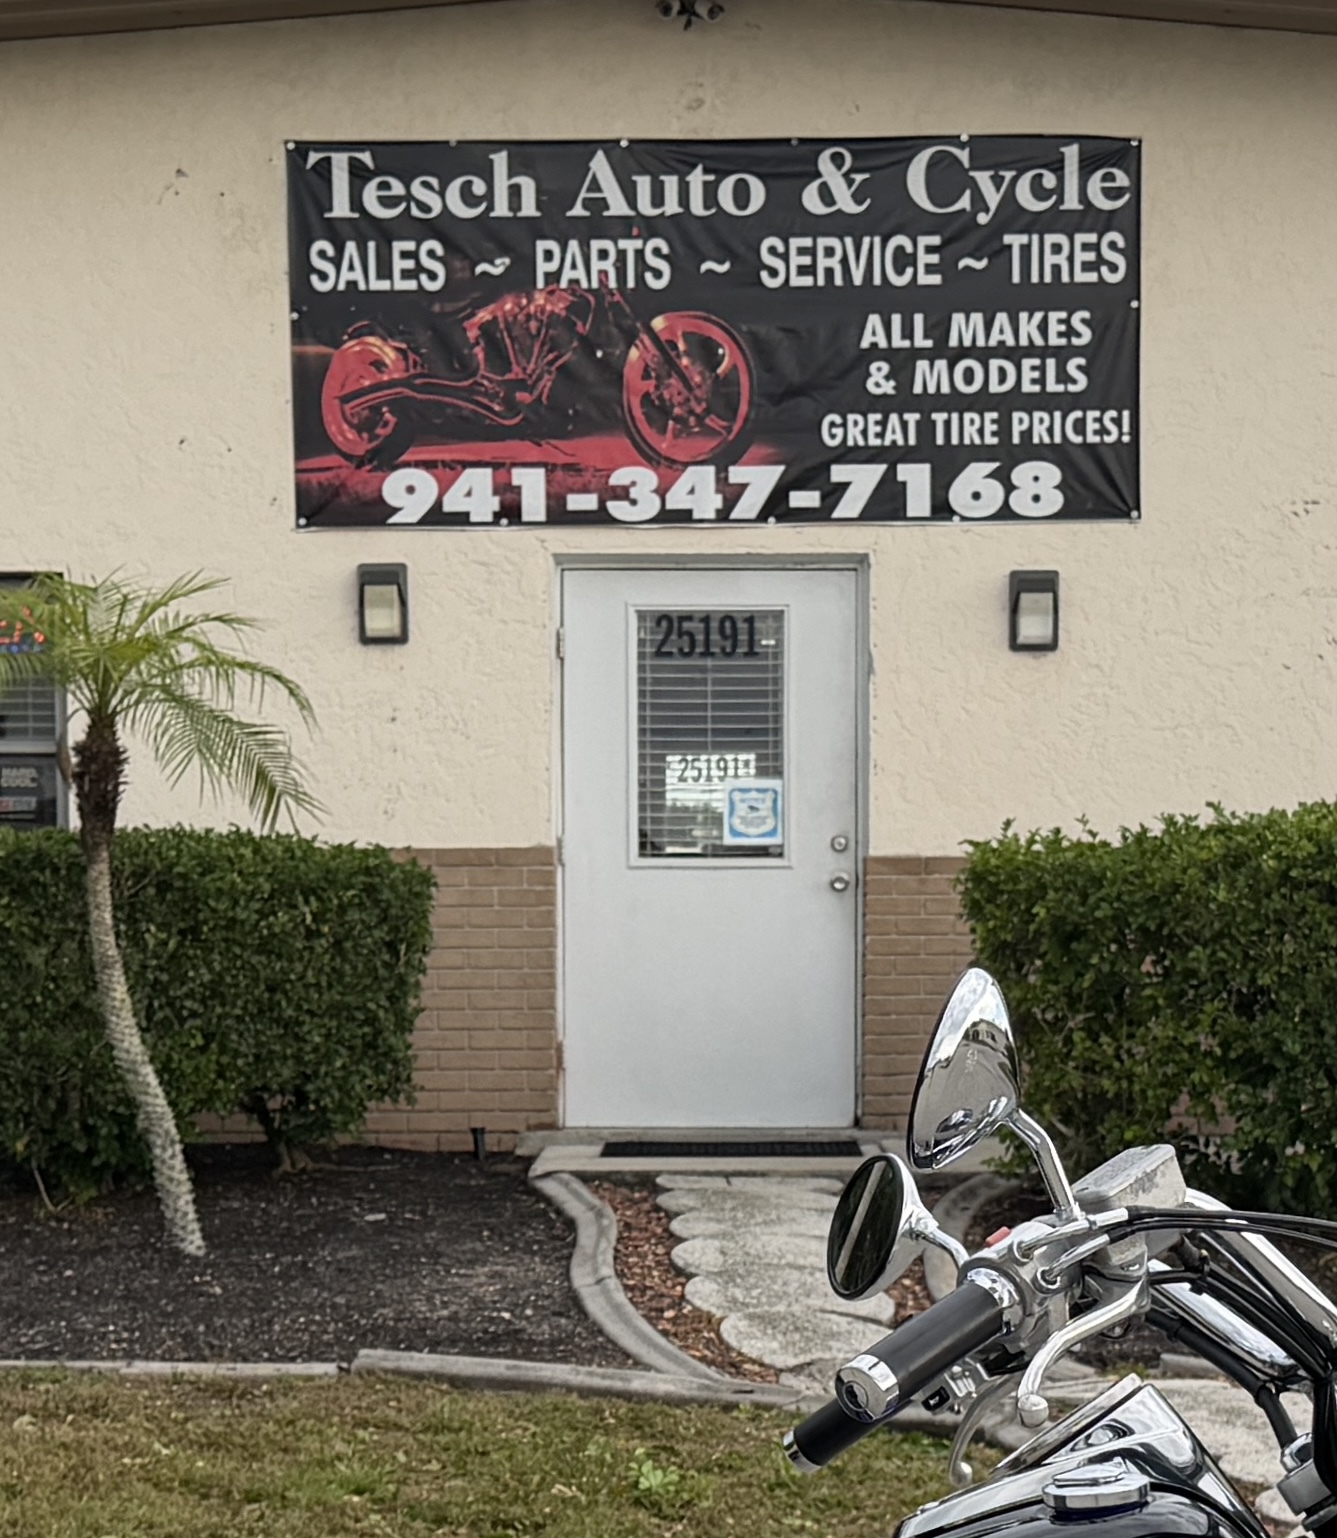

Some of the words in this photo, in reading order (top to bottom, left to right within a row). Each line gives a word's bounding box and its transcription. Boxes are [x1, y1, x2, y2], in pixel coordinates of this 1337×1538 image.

[305, 149, 542, 219] Tesch
[565, 148, 766, 217] Auto
[801, 146, 872, 216] &
[906, 143, 1131, 225] Cycle
[309, 239, 447, 292] SALES
[534, 237, 672, 290] PARTS
[759, 234, 942, 289] SERVICE
[1002, 231, 1127, 285] TIRES
[859, 312, 934, 349] ALL
[948, 310, 1093, 348] MAKES
[865, 361, 897, 395] &
[913, 356, 1089, 395] MODELS
[820, 412, 921, 447] GREAT
[931, 411, 999, 446] TIRE
[1011, 409, 1132, 445] PRICES!
[380, 460, 1065, 525] 941-347-7168
[653, 614, 760, 659] 25191
[677, 757, 739, 783] 25191
